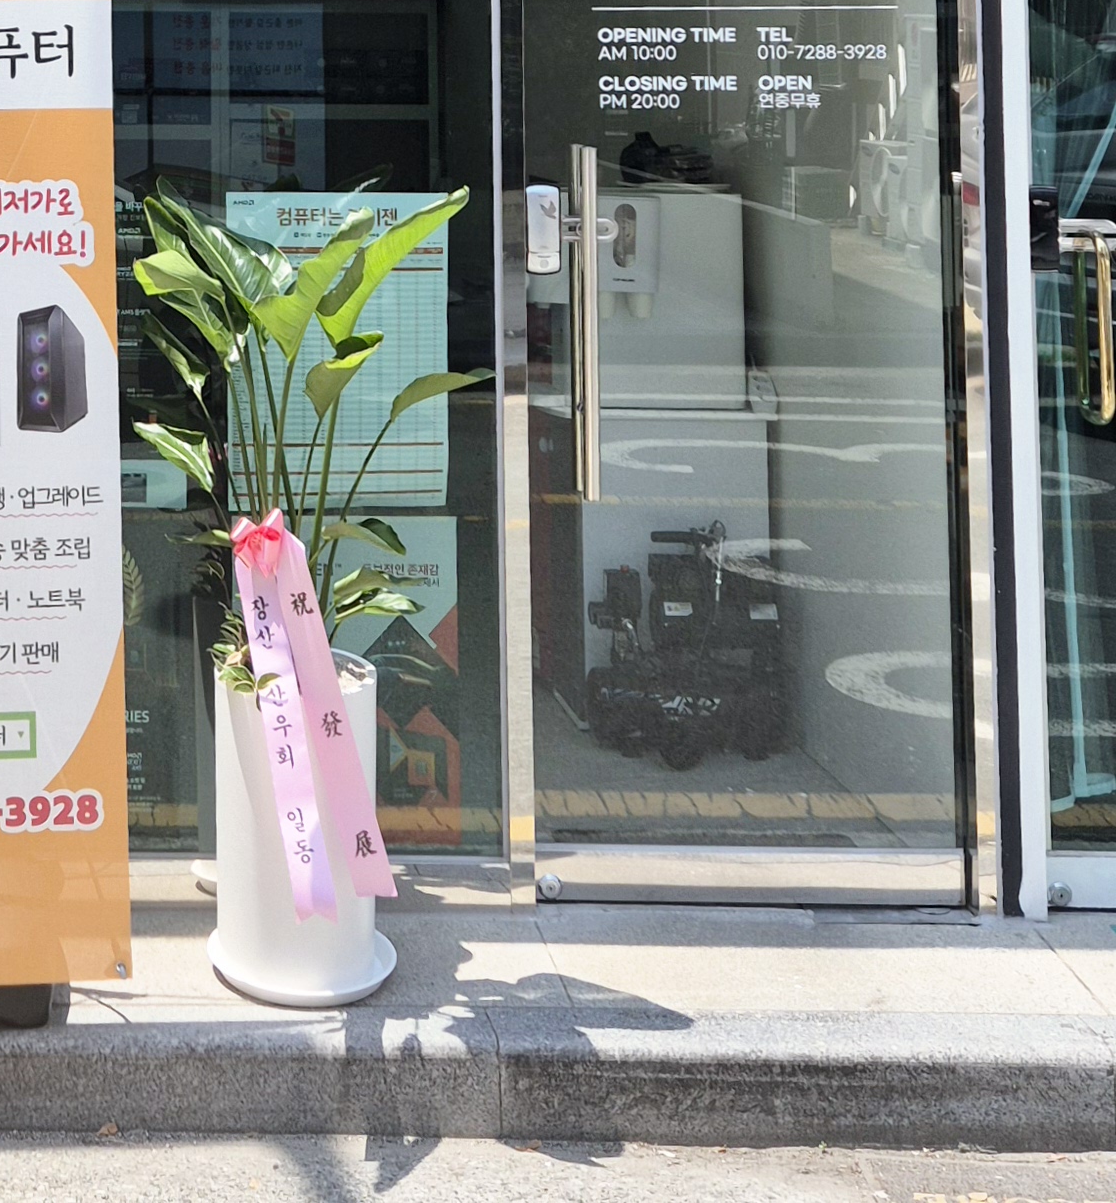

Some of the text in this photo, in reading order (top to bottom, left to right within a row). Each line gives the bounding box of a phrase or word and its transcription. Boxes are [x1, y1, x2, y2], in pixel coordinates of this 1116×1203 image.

[598, 28, 736, 43] OPENING TIME
[756, 27, 792, 42] TEL
[598, 45, 676, 60] AM 10:00
[757, 45, 886, 60] 010-7288-3928
[598, 75, 737, 92] CLOSING TIME
[758, 75, 812, 92] OPEN
[600, 94, 679, 108] PM 20:00
[759, 93, 821, 109] 연중무휴
[276, 207, 344, 226] 컴퓨터는
[18, 486, 103, 509] 업그레이드
[11, 538, 50, 561] 맞춤
[55, 537, 90, 559] 조립
[27, 588, 85, 611] 노트북
[22, 642, 58, 664] 판매
